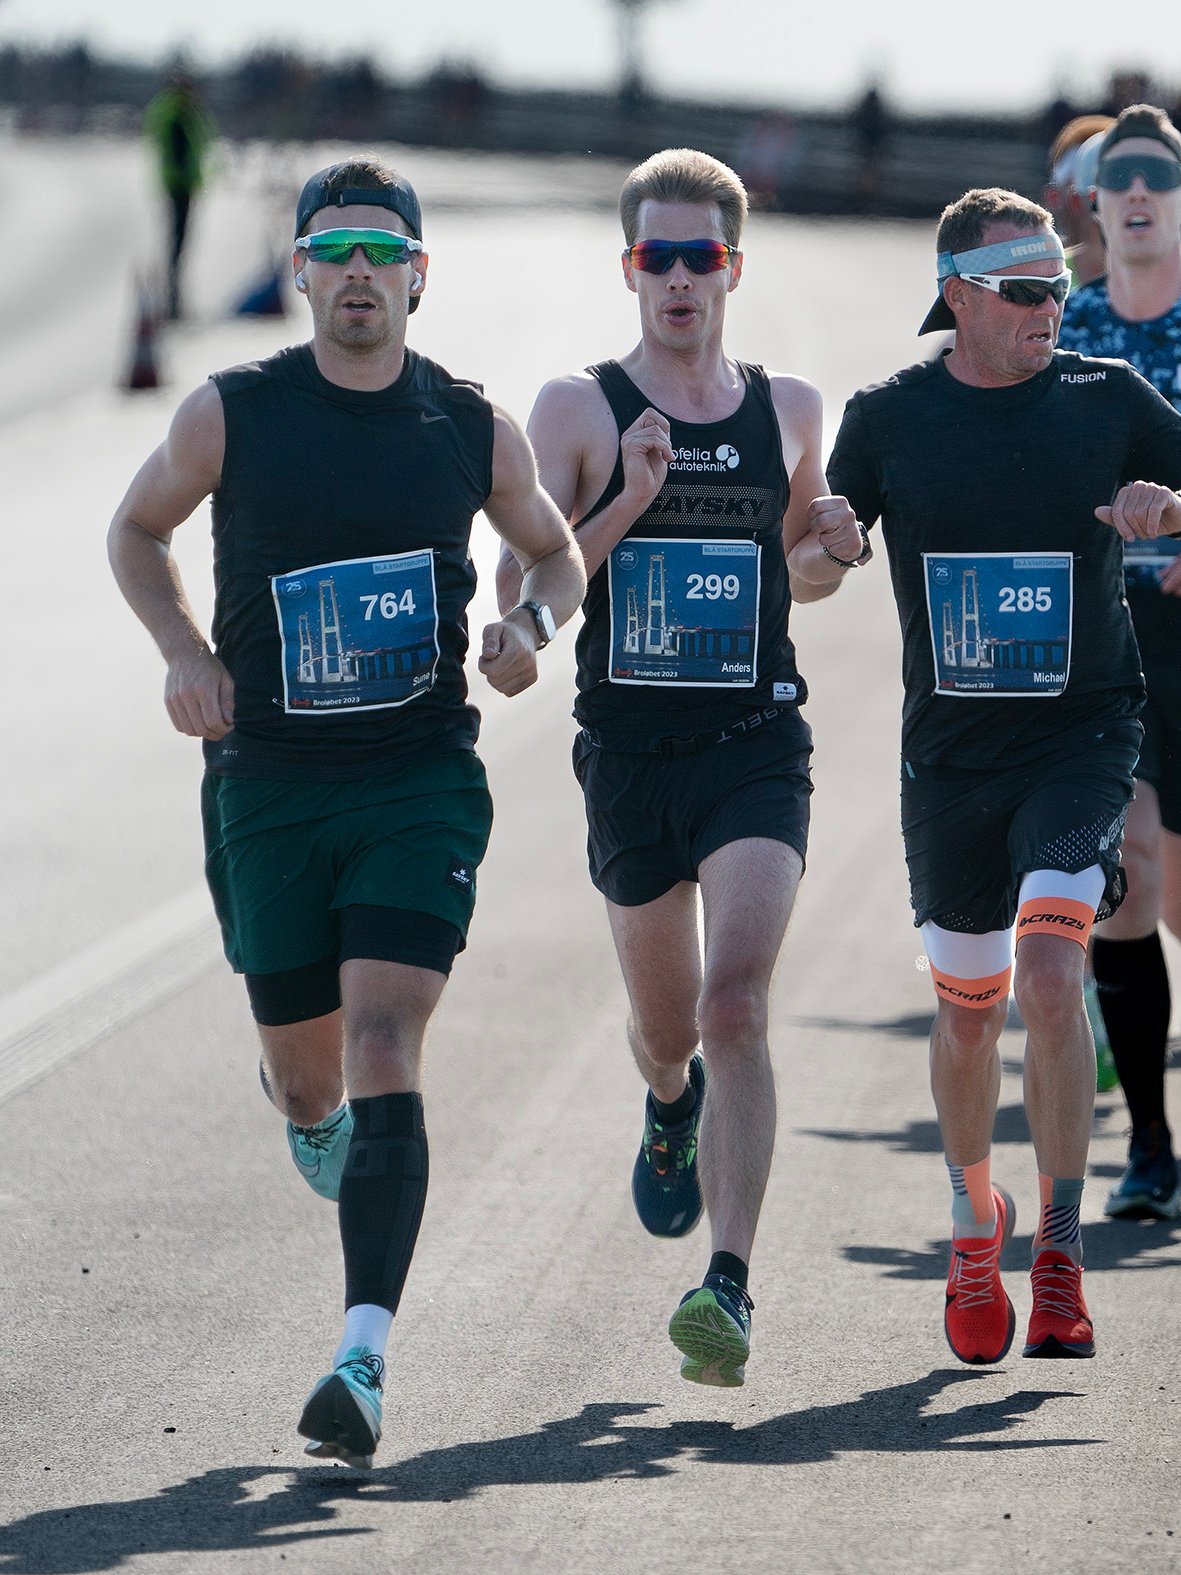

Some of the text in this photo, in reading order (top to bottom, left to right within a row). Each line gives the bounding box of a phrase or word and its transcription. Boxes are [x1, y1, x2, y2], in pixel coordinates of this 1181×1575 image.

[1060, 371, 1107, 384] FUSION
[669, 462, 727, 472] autoteknik
[620, 551, 634, 562] 25
[935, 567, 949, 577] 25
[286, 581, 302, 593] 25
[686, 573, 740, 601] 299
[359, 588, 417, 621] 764
[998, 586, 1053, 613] 285
[721, 662, 751, 673] Anders
[412, 671, 431, 686] Sune
[633, 669, 660, 677] Broløbet
[661, 670, 678, 678] 2023
[1033, 672, 1066, 683] Michael
[313, 698, 342, 706] Broløbet
[342, 696, 361, 704] 2023
